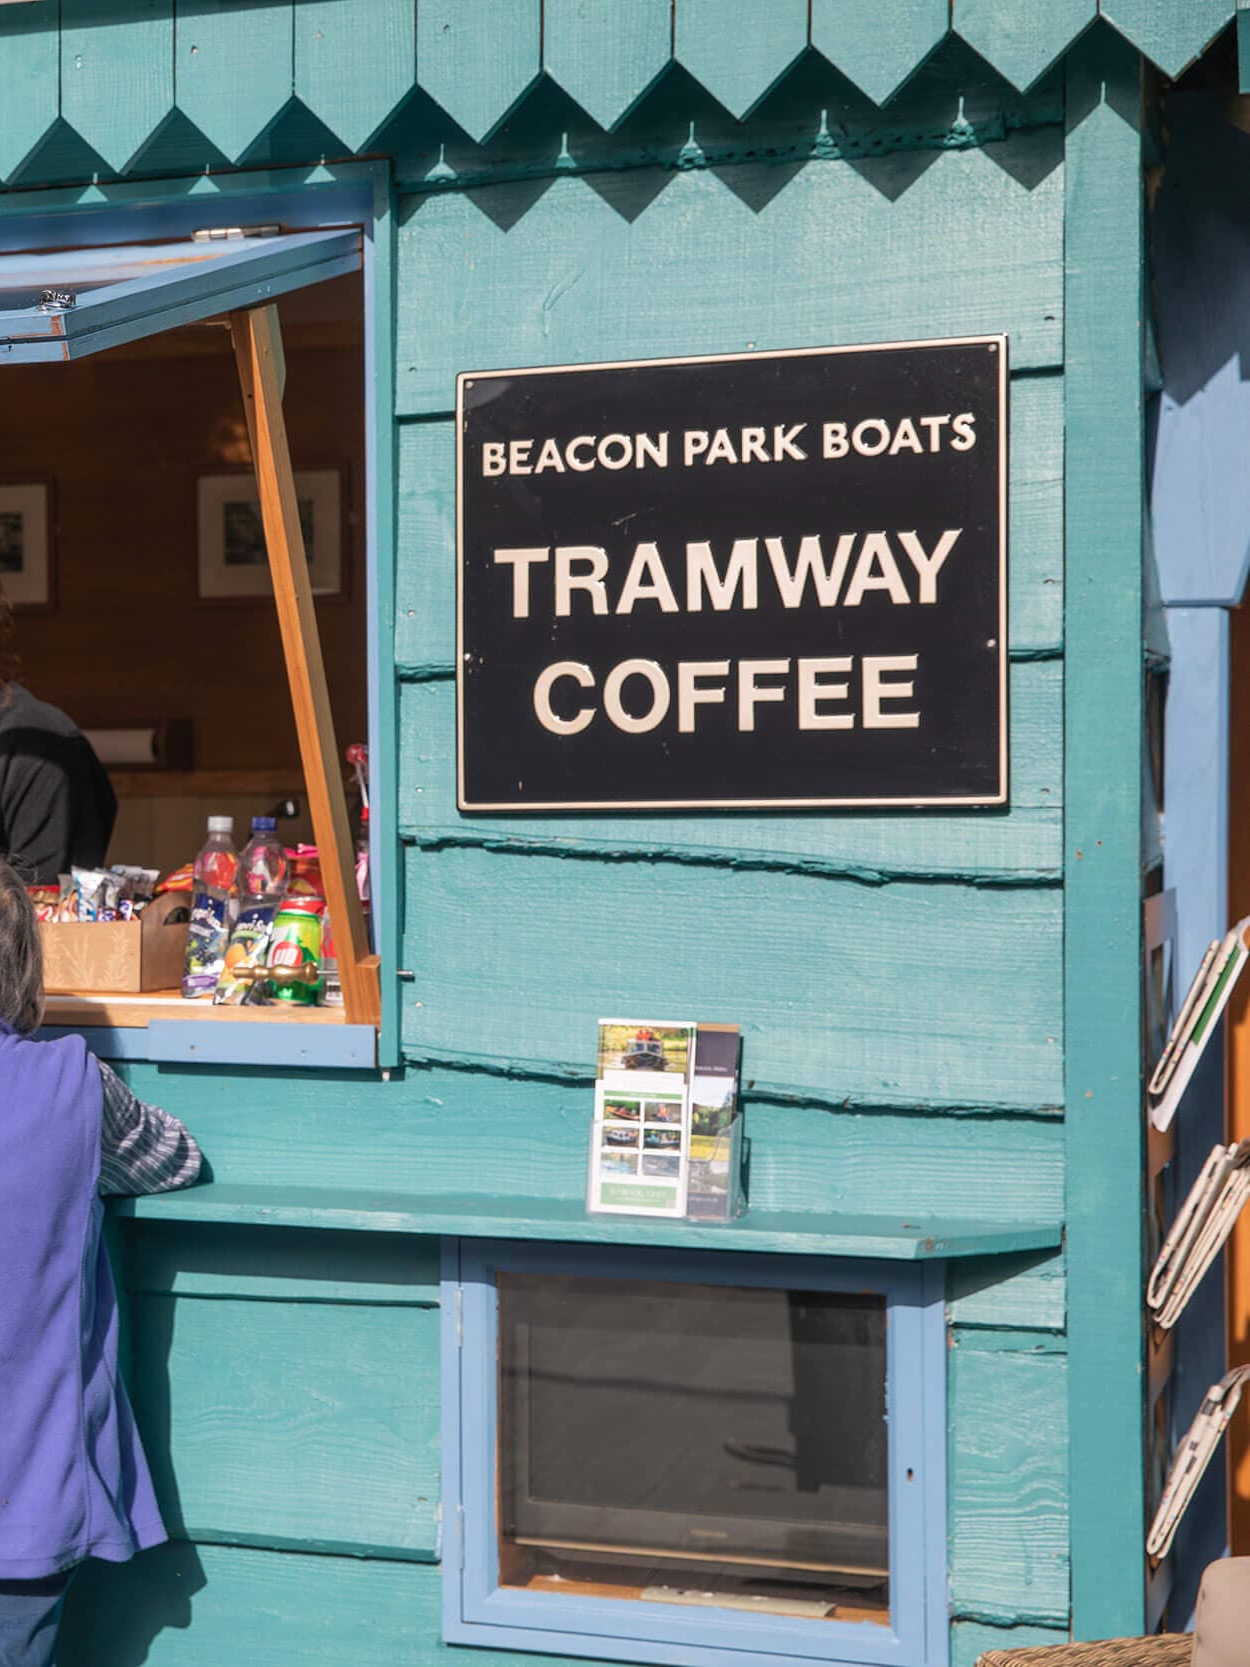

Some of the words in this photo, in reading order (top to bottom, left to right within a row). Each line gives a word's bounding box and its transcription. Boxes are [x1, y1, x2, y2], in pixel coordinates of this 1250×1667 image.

[482, 432, 669, 478] BEACON
[682, 422, 808, 468] PARK
[822, 412, 977, 460] BOATS
[494, 528, 963, 619] TRAMWAY
[533, 654, 920, 736] COFFEE
